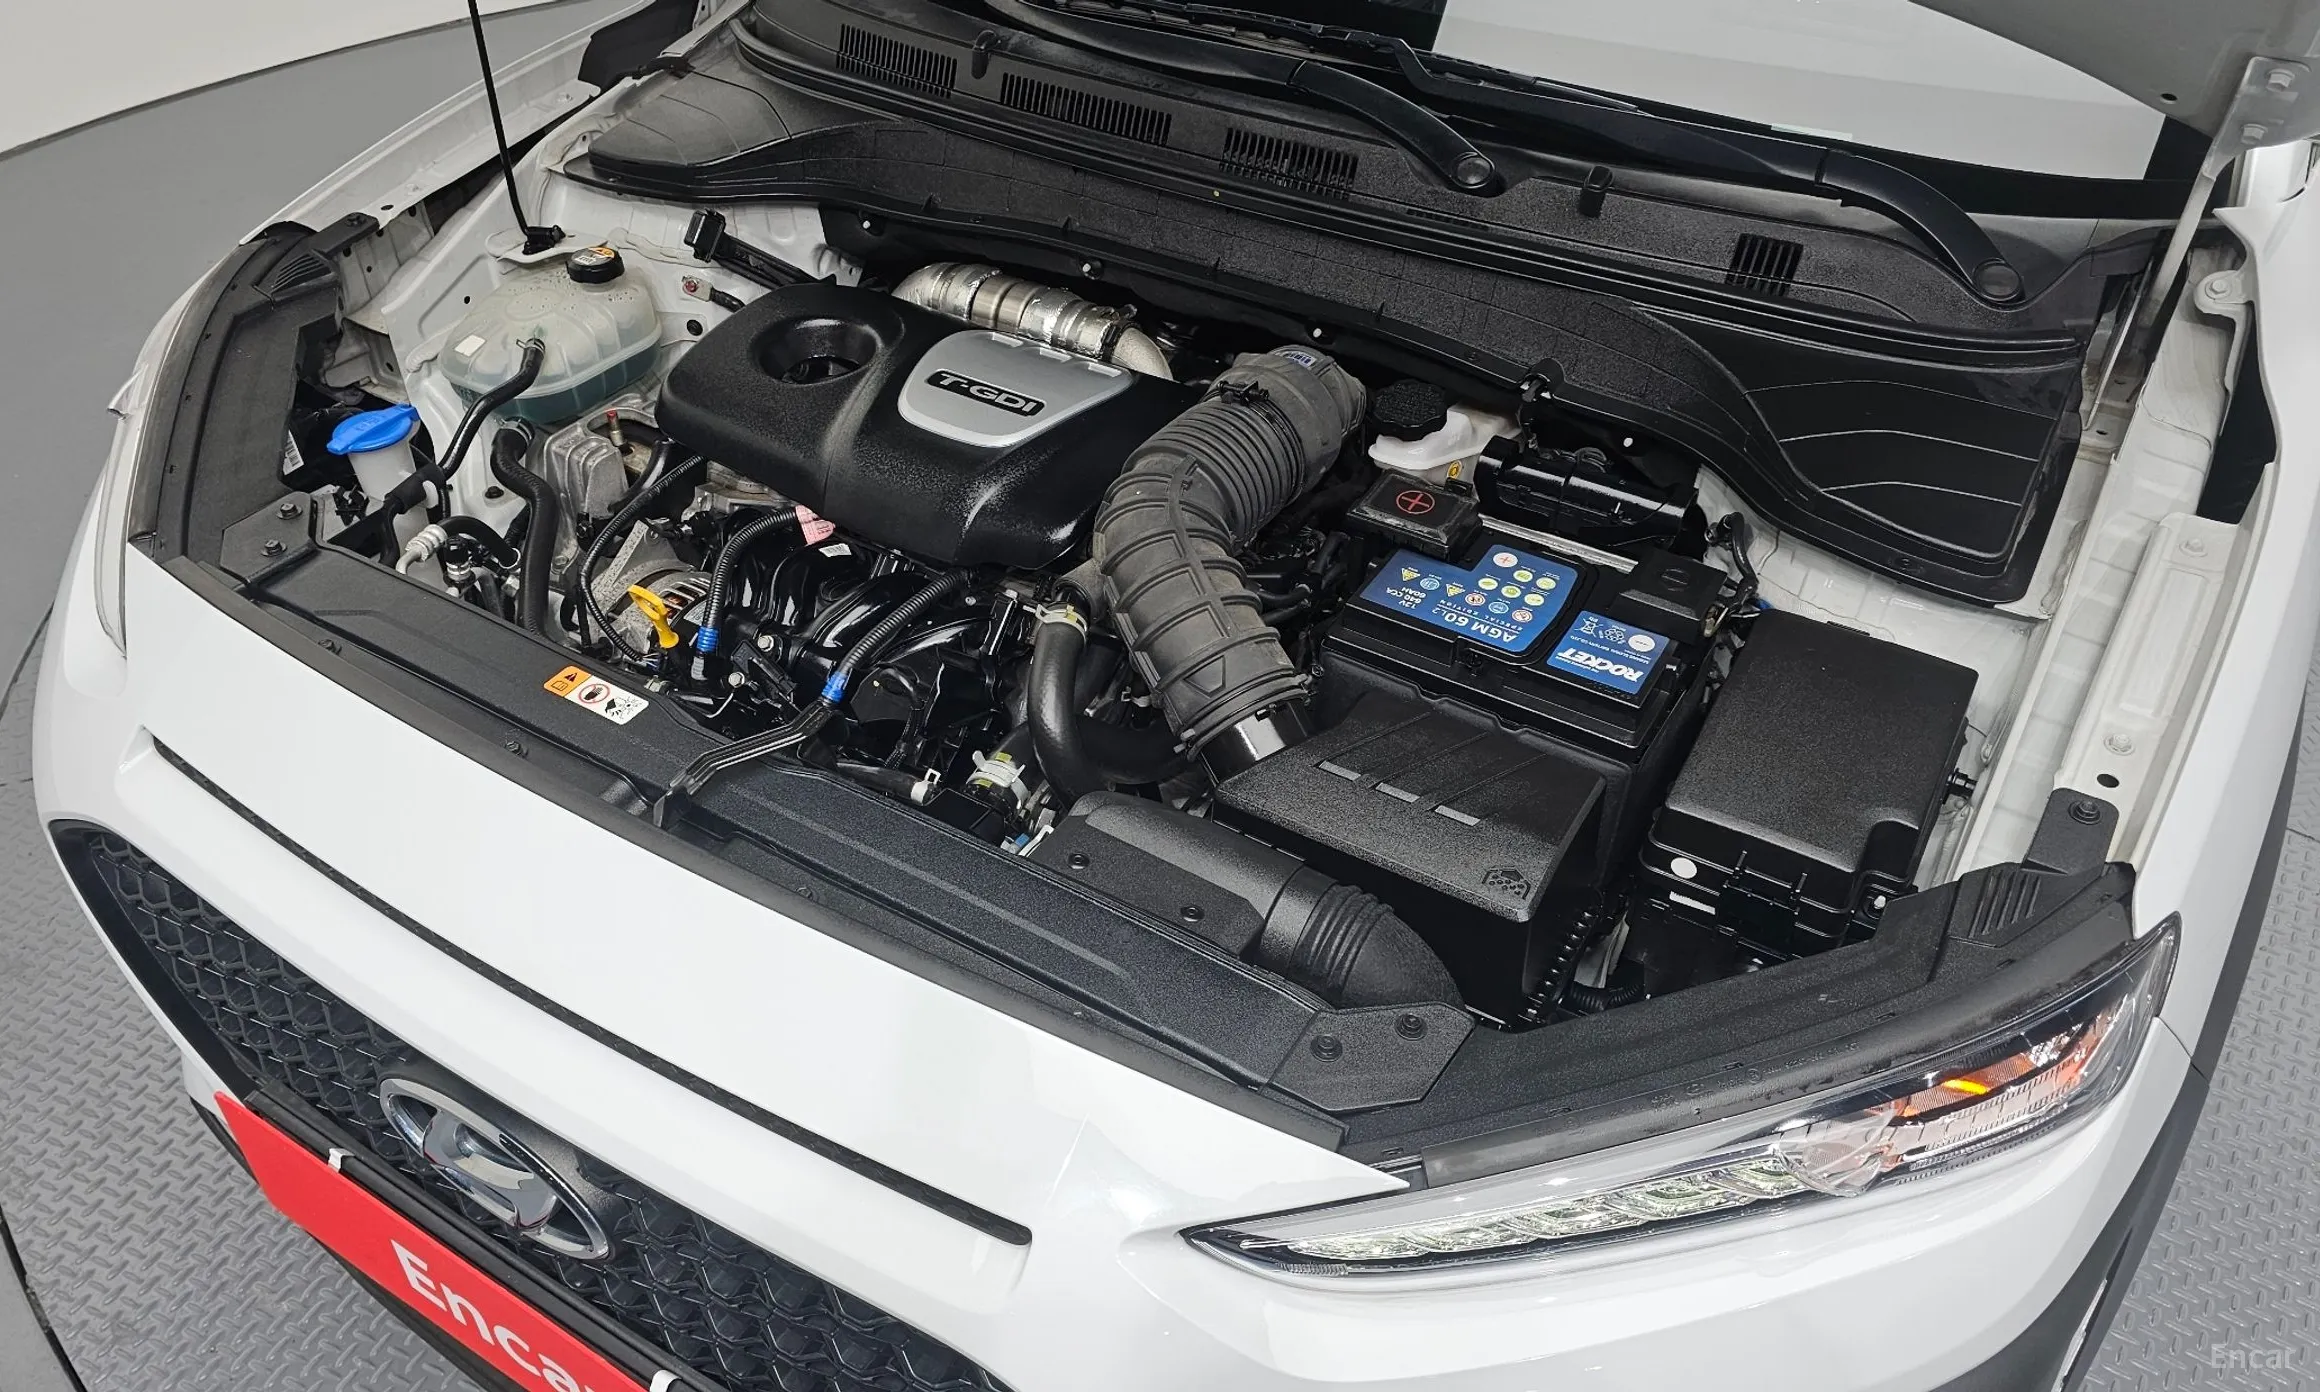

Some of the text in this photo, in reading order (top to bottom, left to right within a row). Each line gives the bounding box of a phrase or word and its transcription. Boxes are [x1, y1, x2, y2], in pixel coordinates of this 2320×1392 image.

[940, 373, 1037, 412] T-GDI
[1439, 599, 1523, 631] SPECIAL EDITION
[1471, 621, 1519, 642] AGM
[1557, 647, 1644, 682] ROCKET
[390, 1239, 595, 1392] Enca
